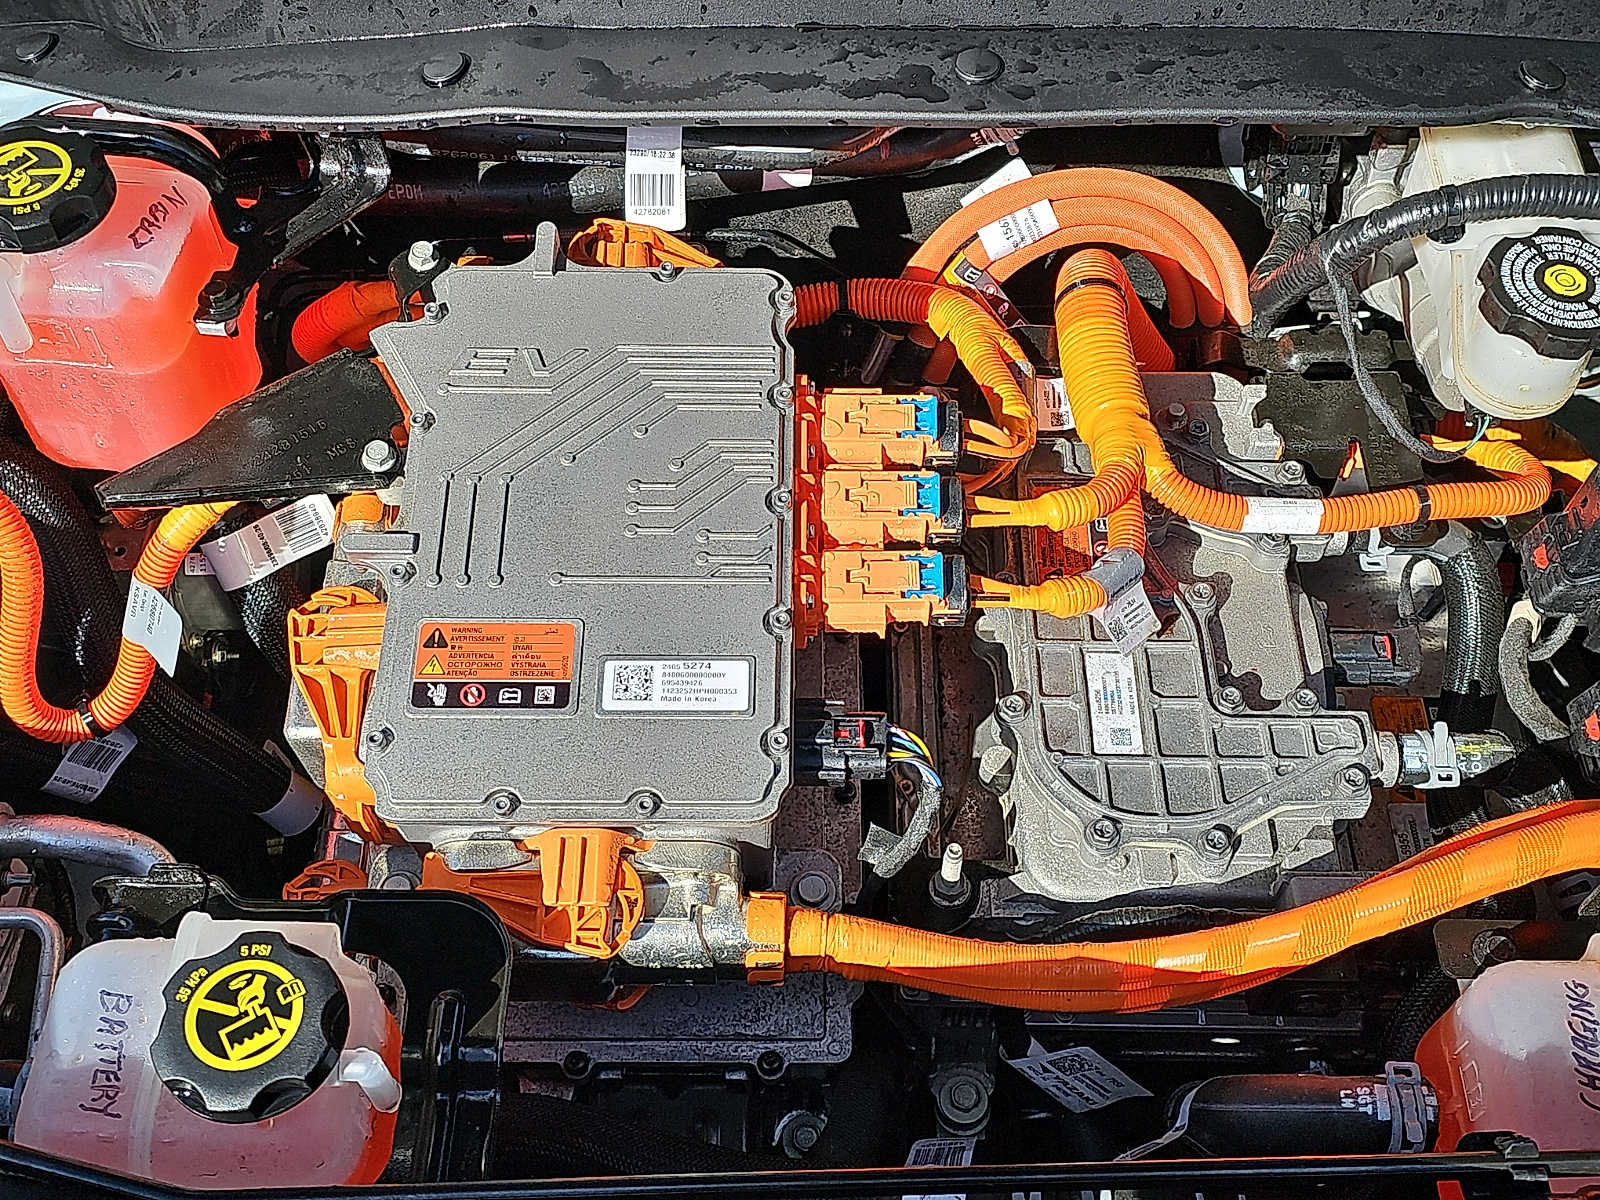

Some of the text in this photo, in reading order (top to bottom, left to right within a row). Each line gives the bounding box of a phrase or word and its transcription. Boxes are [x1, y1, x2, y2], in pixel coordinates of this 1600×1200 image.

[13, 204, 33, 216] PSI
[1532, 235, 1582, 247] CONTAINER
[1541, 243, 1561, 253] ONLY
[1562, 244, 1580, 254] USE
[1545, 252, 1576, 261] FILLER
[1575, 257, 1600, 276] CLEAN
[1516, 299, 1529, 310] LE
[1535, 303, 1554, 315] QUE
[1545, 298, 1588, 310] PROVENANT
[1525, 305, 1563, 326] NETTOYER
[449, 347, 590, 376] EV
[683, 661, 712, 670] 5274
[240, 943, 273, 957] 5 PSI
[175, 967, 209, 1003] 35 kPa
[79, 989, 134, 1119] BATTERY
